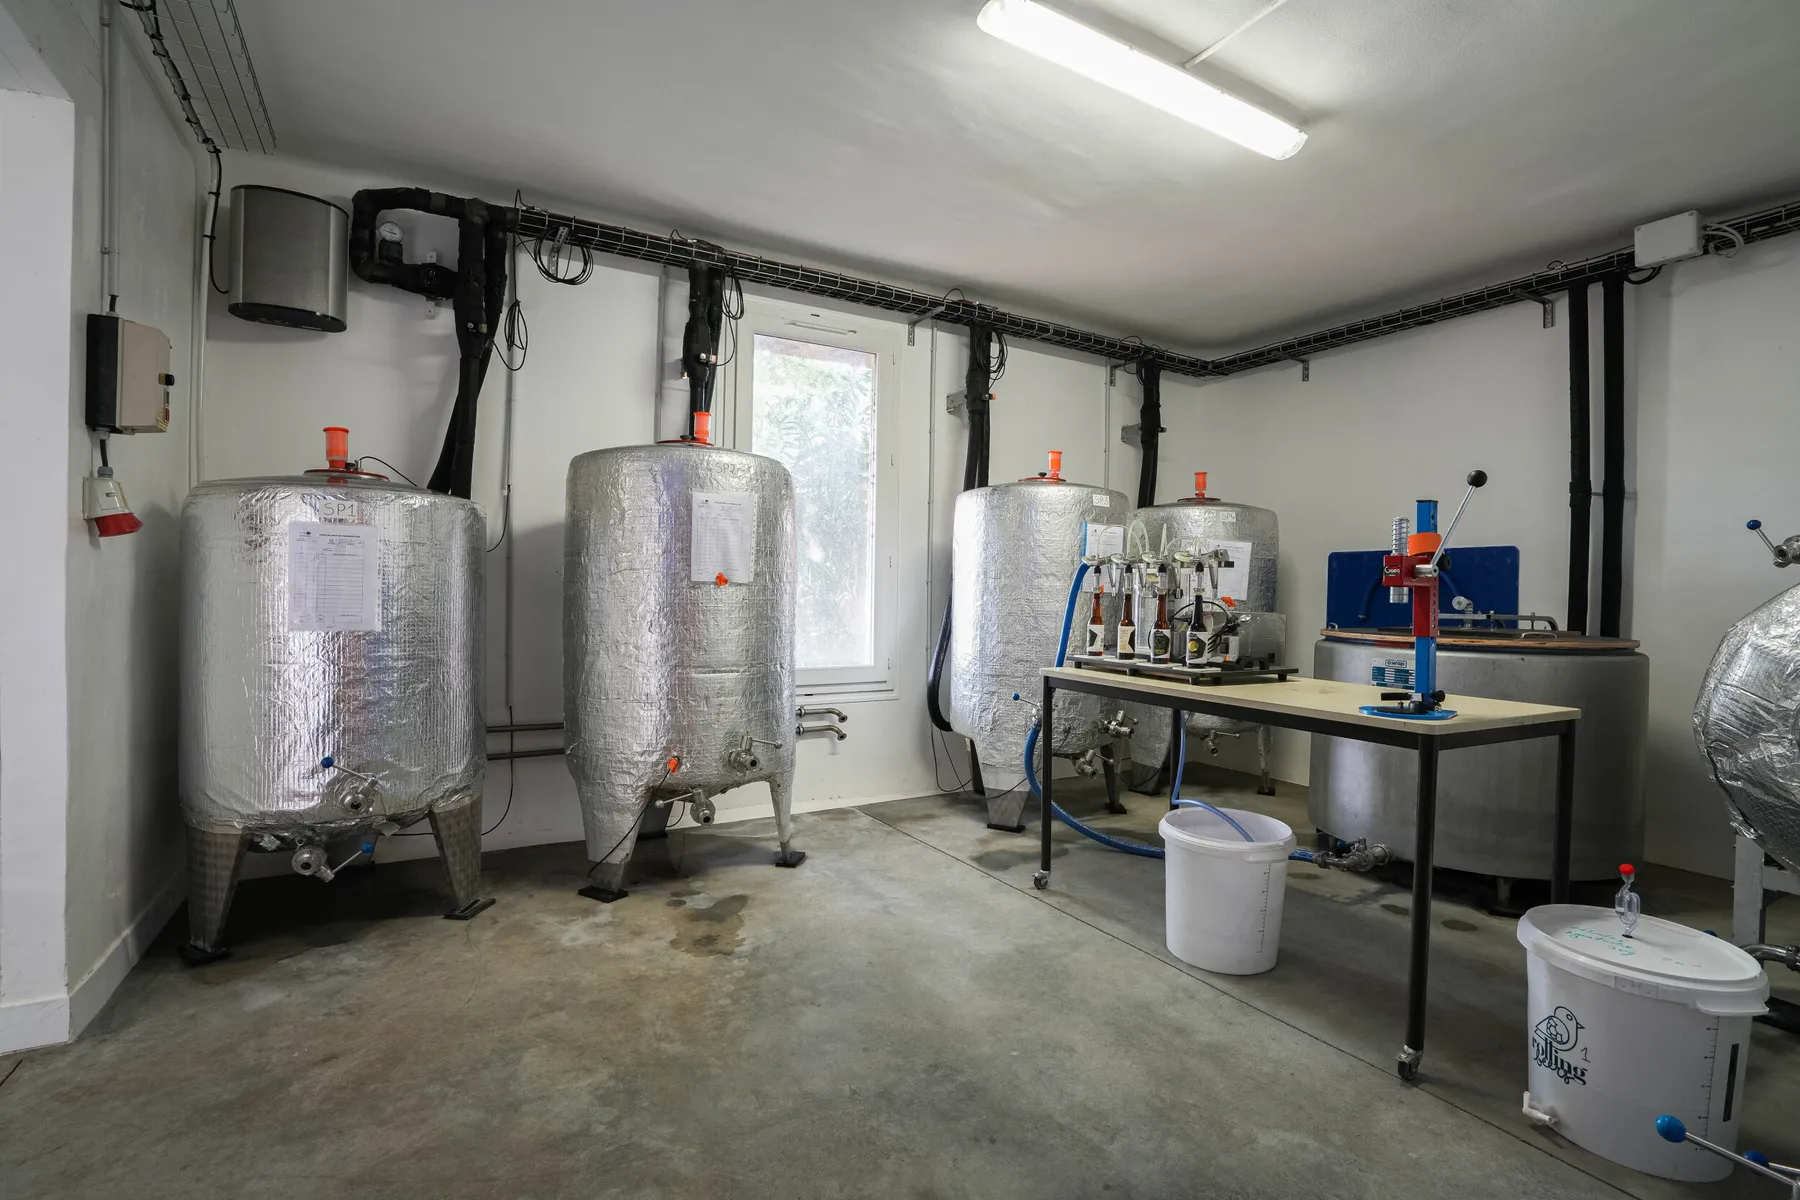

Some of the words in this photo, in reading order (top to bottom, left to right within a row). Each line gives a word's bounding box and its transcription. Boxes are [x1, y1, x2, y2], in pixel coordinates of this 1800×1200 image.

[715, 462, 736, 475] SP2
[1094, 495, 1108, 506] SP3
[323, 502, 356, 517] SP1
[1532, 1035, 1588, 1086] rolling
[1580, 1046, 1592, 1064] 1
